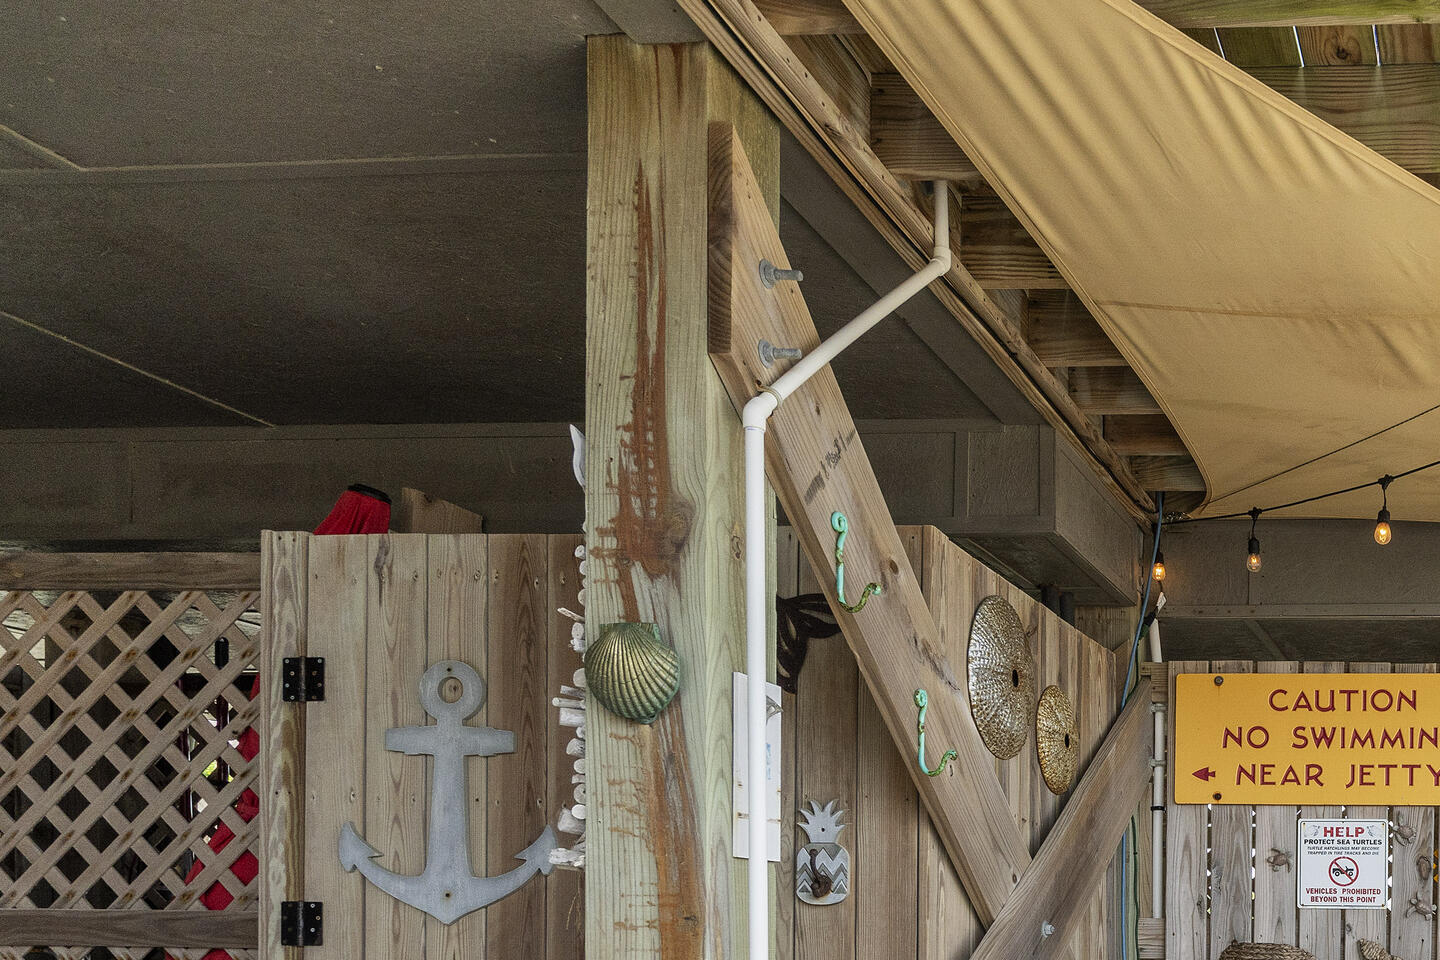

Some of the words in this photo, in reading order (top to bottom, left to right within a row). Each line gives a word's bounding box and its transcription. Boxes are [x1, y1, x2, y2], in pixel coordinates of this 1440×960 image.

[1268, 689, 1417, 713] CAUTION
[1222, 726, 1270, 749] NO
[1235, 763, 1324, 787] NEAR
[1324, 826, 1365, 837] HELP
